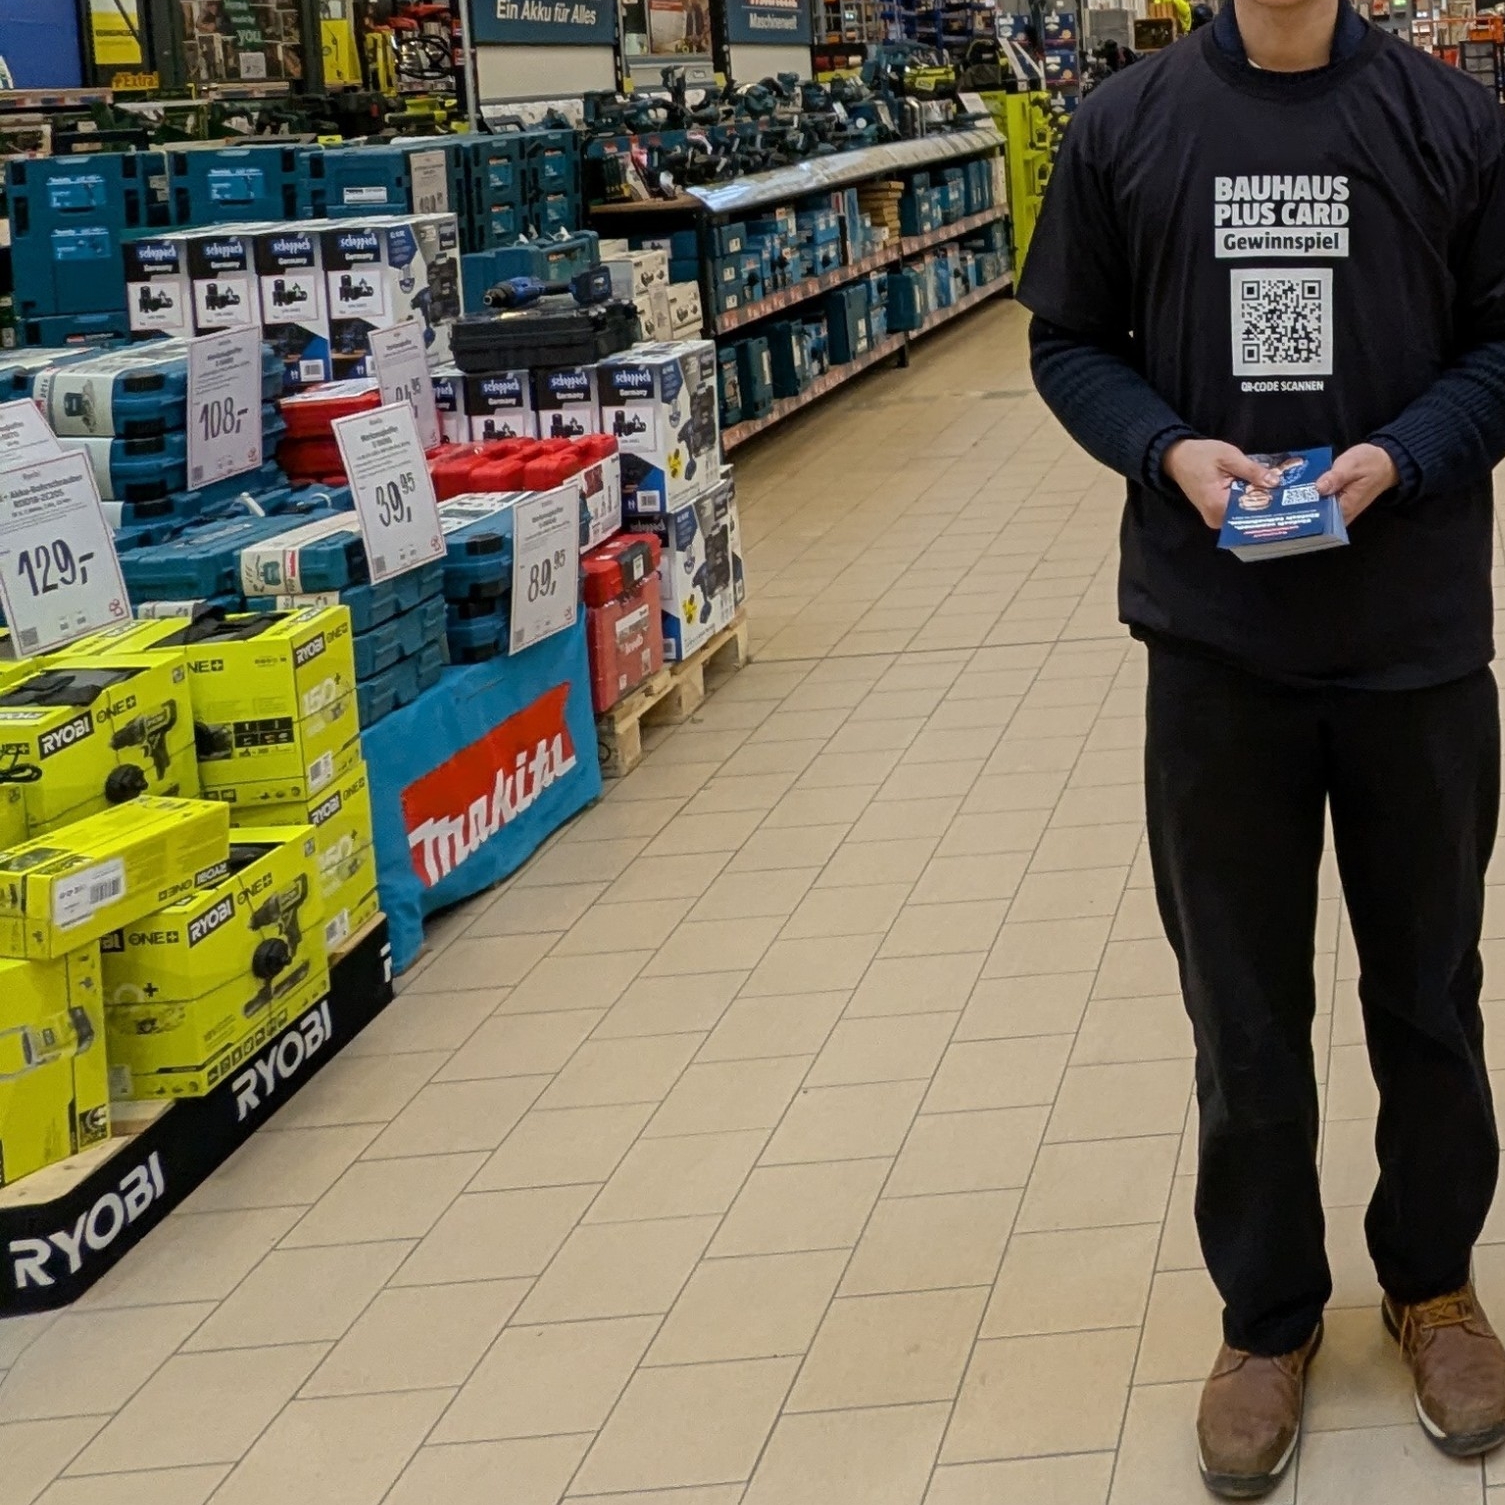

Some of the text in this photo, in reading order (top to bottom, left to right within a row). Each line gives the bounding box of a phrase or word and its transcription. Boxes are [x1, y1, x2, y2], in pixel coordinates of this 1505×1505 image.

[522, 2, 552, 23] Akku
[554, 2, 571, 23] für
[571, 4, 597, 26] Alles
[1215, 174, 1349, 202] BAUHAUS
[1215, 202, 1349, 226] PLUS CARD
[139, 245, 177, 263] scheppach
[340, 233, 378, 252] scheppach
[1223, 231, 1340, 253] Gewinnspiel
[482, 376, 520, 395] scheppach
[551, 372, 589, 391] scheppach
[615, 370, 653, 389] scheppach
[1241, 380, 1324, 391] QR-CODE SCANNEN
[199, 396, 249, 441] 108,-
[19, 538, 95, 597] 129,-
[297, 635, 326, 665] RYOBI
[41, 717, 91, 755] RYOBI
[311, 793, 341, 825] RYOBI
[408, 731, 578, 889] makita
[190, 899, 233, 942] RYOBI
[231, 999, 332, 1123] RYOBI
[10, 1150, 166, 1290] RYOBI
